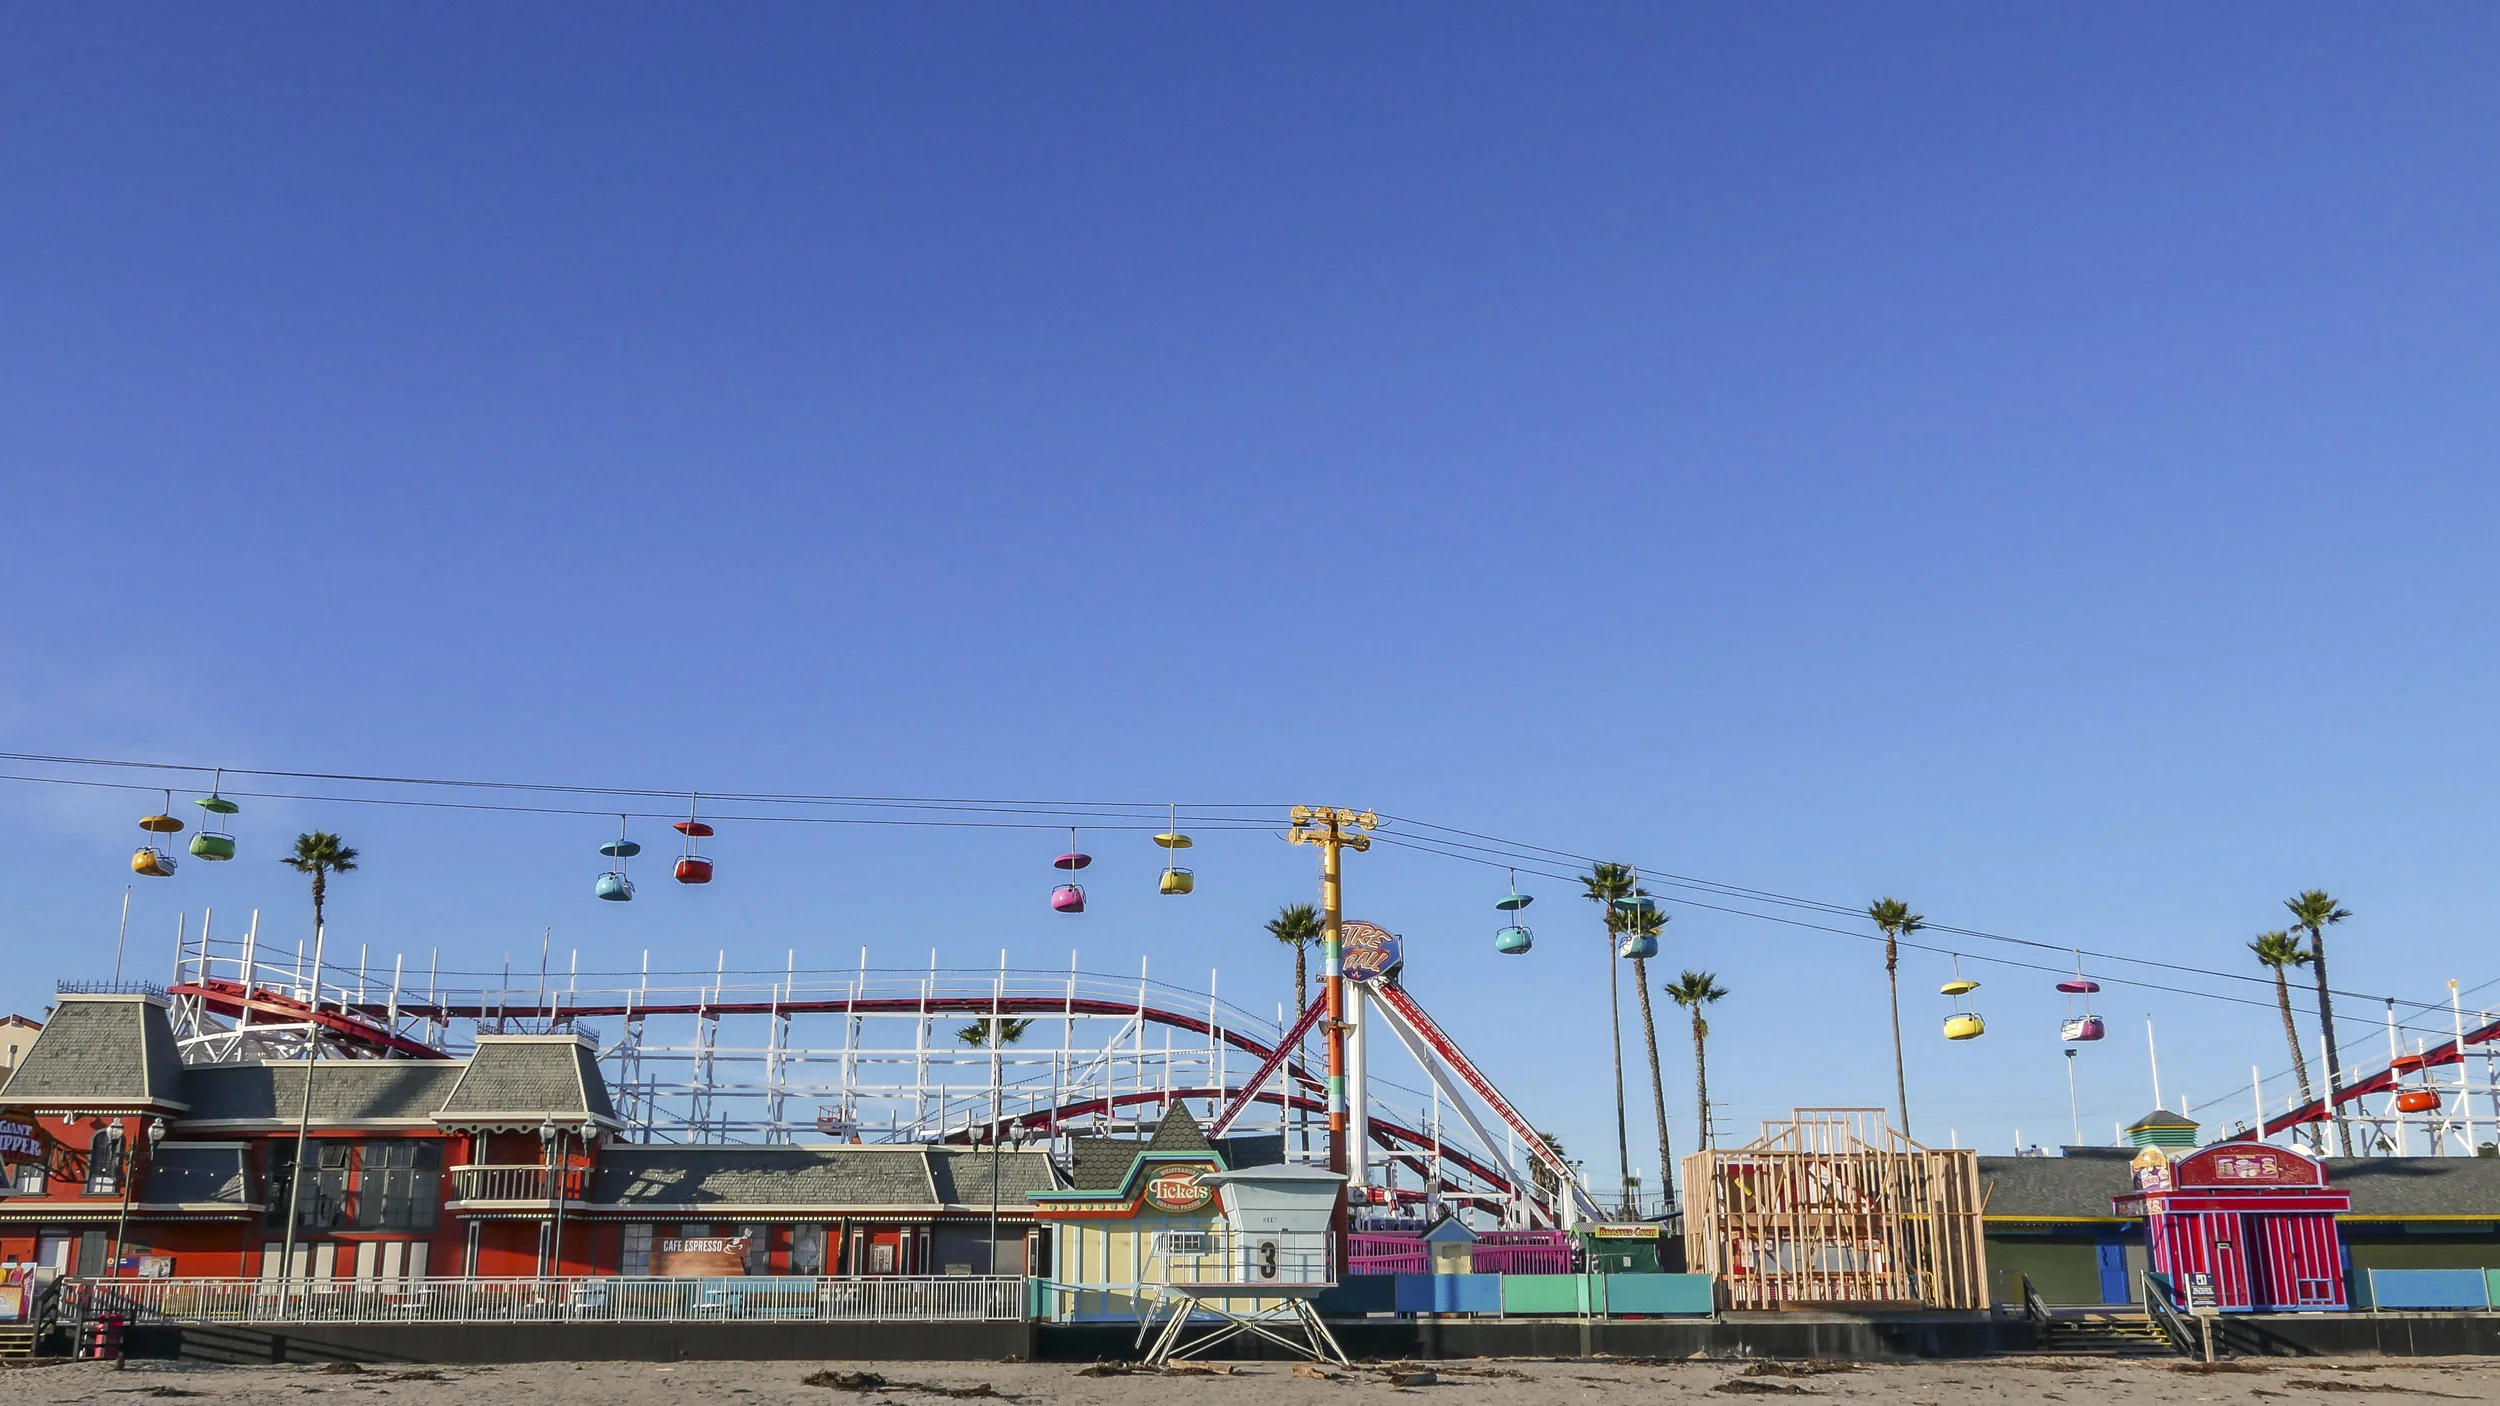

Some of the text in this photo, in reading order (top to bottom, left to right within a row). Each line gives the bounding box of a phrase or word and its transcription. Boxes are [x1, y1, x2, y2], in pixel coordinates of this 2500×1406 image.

[1342, 924, 1393, 949] IRE
[1342, 951, 1389, 973] BALL
[0, 1120, 33, 1136] GIANT
[1149, 1173, 1208, 1199] Tickets
[663, 1240, 722, 1252] CAFE ESPRESSO
[1261, 1242, 1276, 1278] 3
